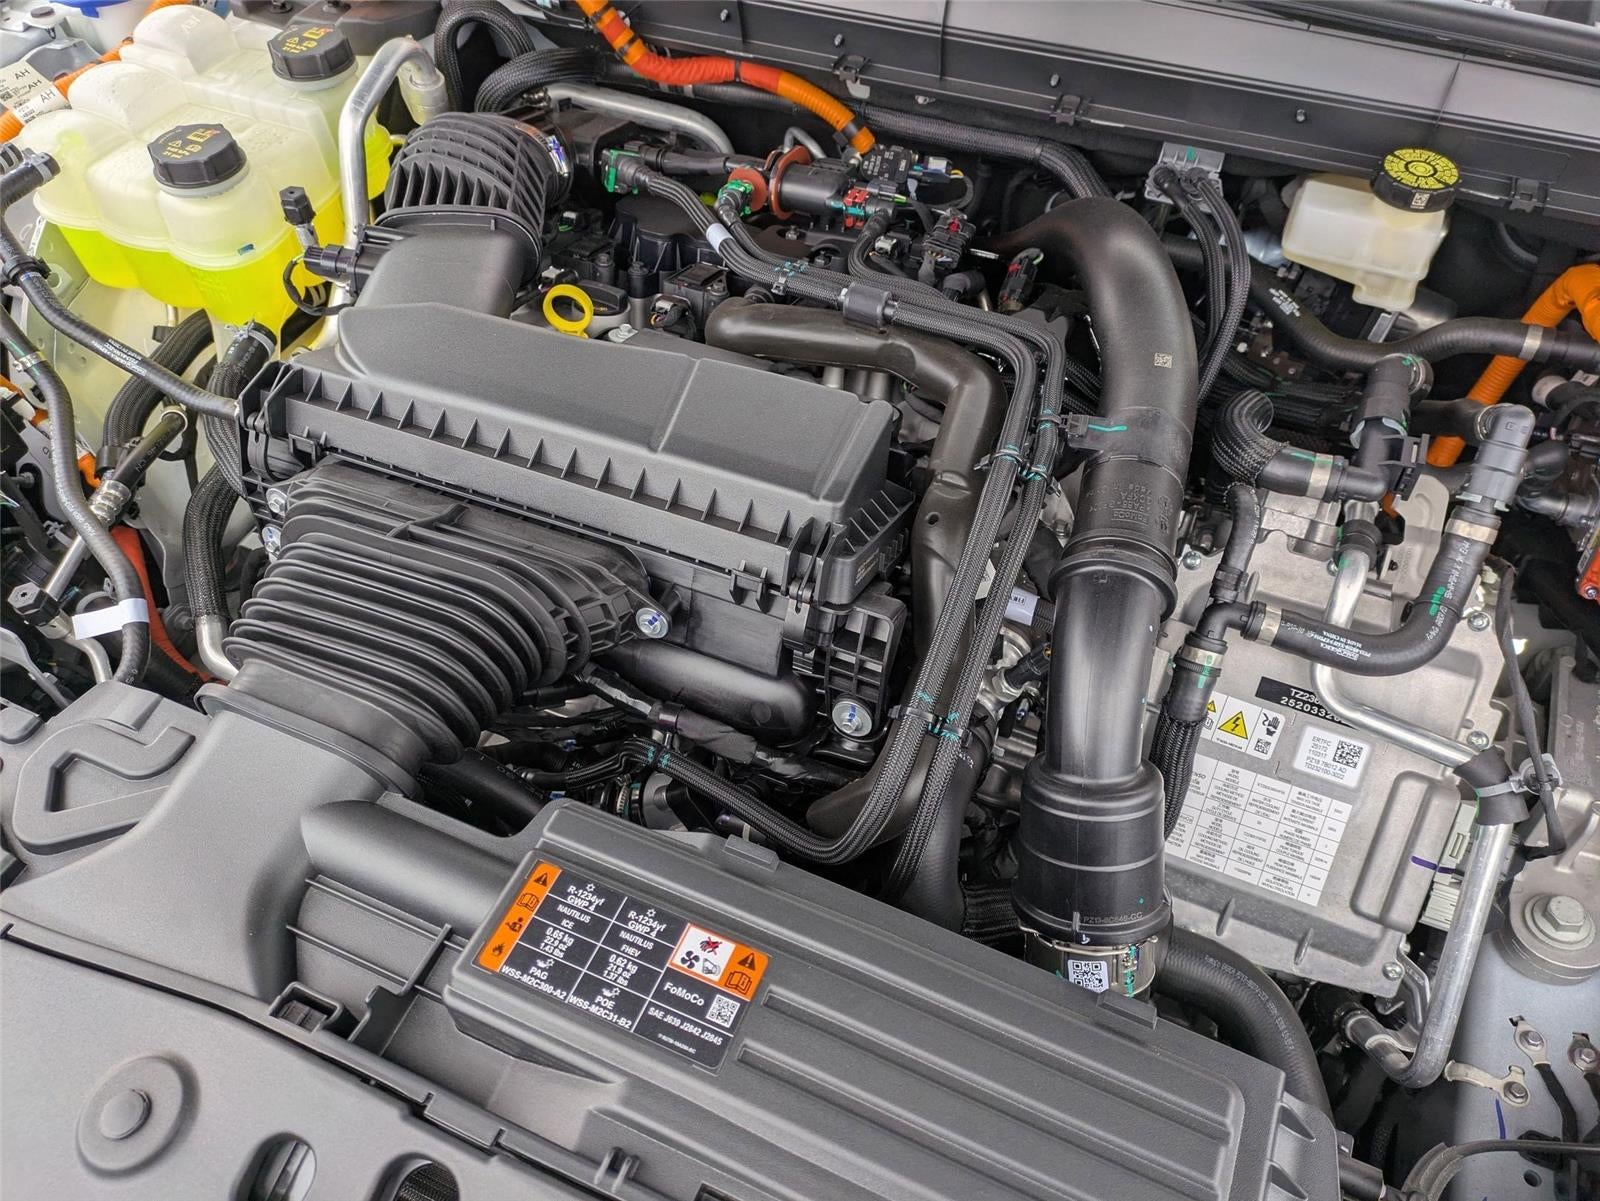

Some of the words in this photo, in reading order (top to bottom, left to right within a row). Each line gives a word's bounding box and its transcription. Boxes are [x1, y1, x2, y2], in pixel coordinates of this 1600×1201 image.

[40, 88, 56, 103] AH
[567, 885, 605, 906] R-1234yf
[567, 895, 589, 907] GWP
[589, 904, 596, 913] 4
[557, 904, 591, 923] NAUTILUS
[627, 910, 667, 932] R-1234yf
[561, 919, 575, 929] ICE
[628, 920, 650, 933] GWP
[650, 930, 657, 938] 4
[546, 927, 564, 940] 0.65
[562, 934, 574, 947] kg
[619, 930, 654, 950] NAUTILUS
[552, 948, 565, 958] lbs
[620, 944, 641, 957] FHEV
[529, 966, 548, 980] PAG
[606, 963, 623, 975] 21.9
[621, 971, 632, 979] oz
[609, 954, 628, 968] 0.62
[626, 961, 638, 974] kg
[501, 963, 567, 1000] WSS-M2C300-A2
[603, 970, 618, 981] 1.37
[616, 976, 629, 986] lbs
[594, 995, 616, 1010] POE
[663, 982, 705, 1006] FoMoCo
[569, 994, 632, 1029] WSS-M2C31-B2
[648, 1007, 665, 1020] SAE
[663, 1014, 681, 1027] J639
